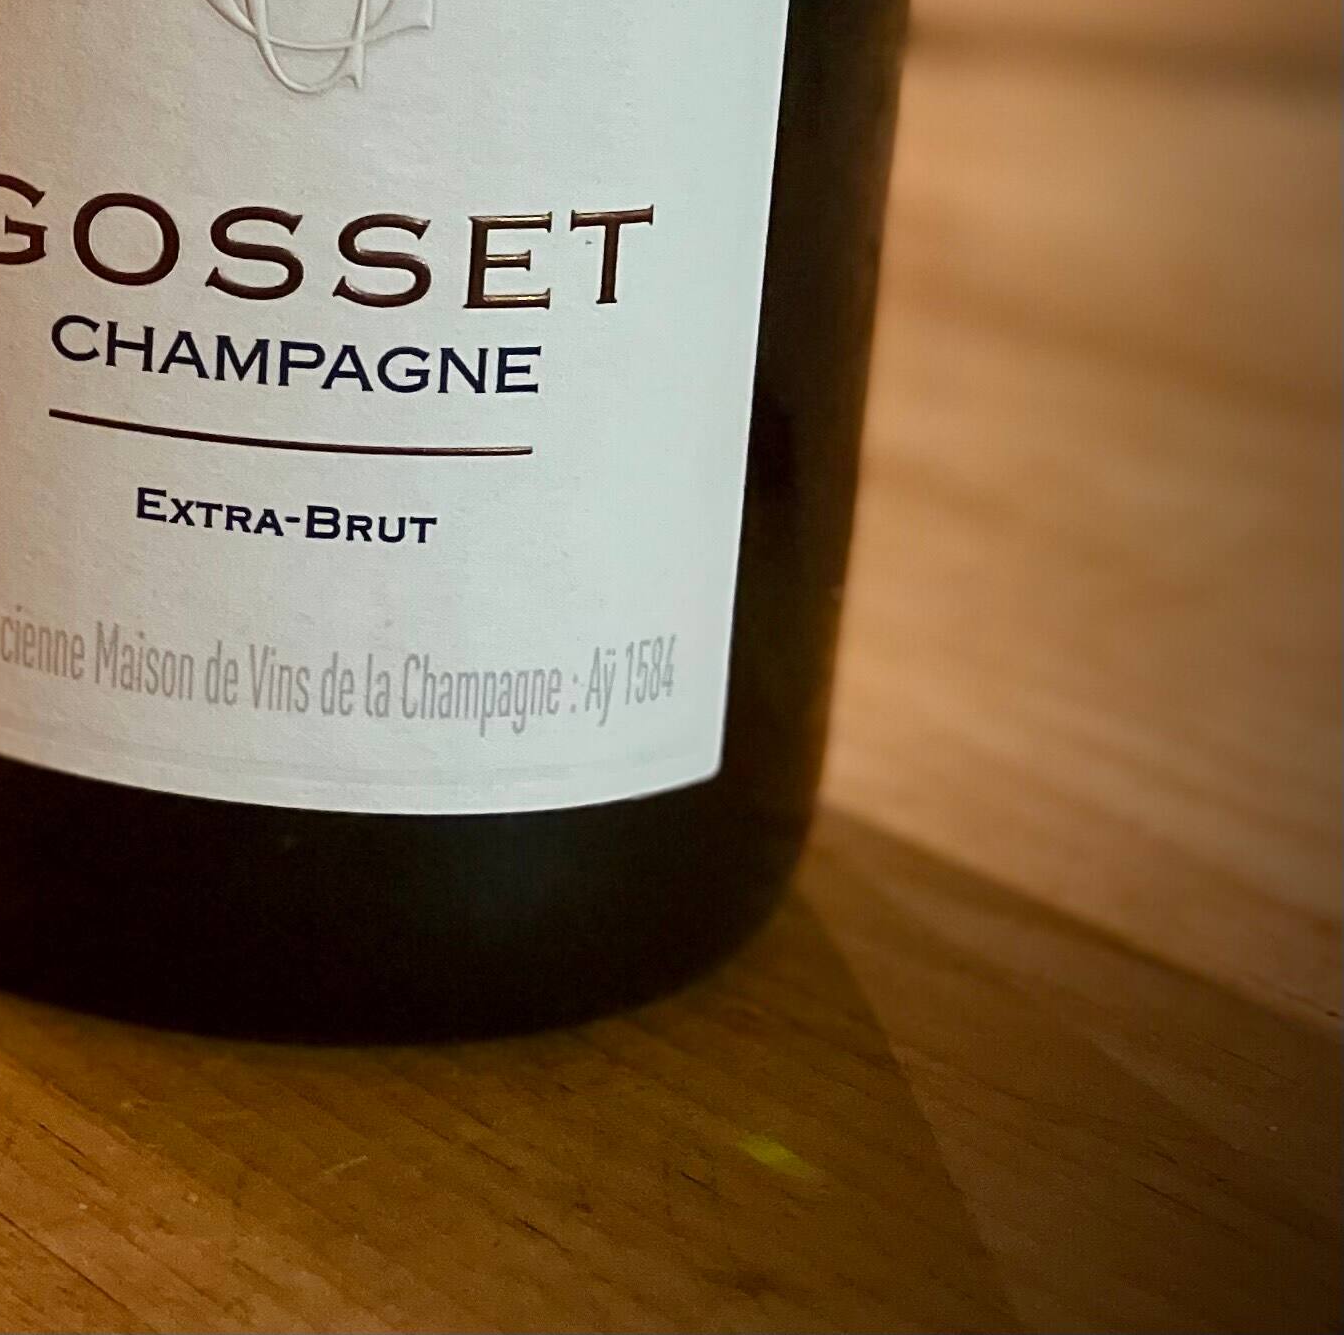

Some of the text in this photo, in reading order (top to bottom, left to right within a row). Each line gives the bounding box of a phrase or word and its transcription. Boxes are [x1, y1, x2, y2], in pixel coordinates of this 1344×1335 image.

[50, 314, 543, 396] CHAMPAGNE
[95, 620, 194, 702] Maison
[205, 640, 239, 705] de
[249, 643, 310, 714] Vins
[320, 651, 354, 716] de
[365, 652, 390, 718] la
[402, 653, 563, 738] Champagne
[585, 646, 617, 727] Aÿ
[625, 634, 676, 706] 1584
